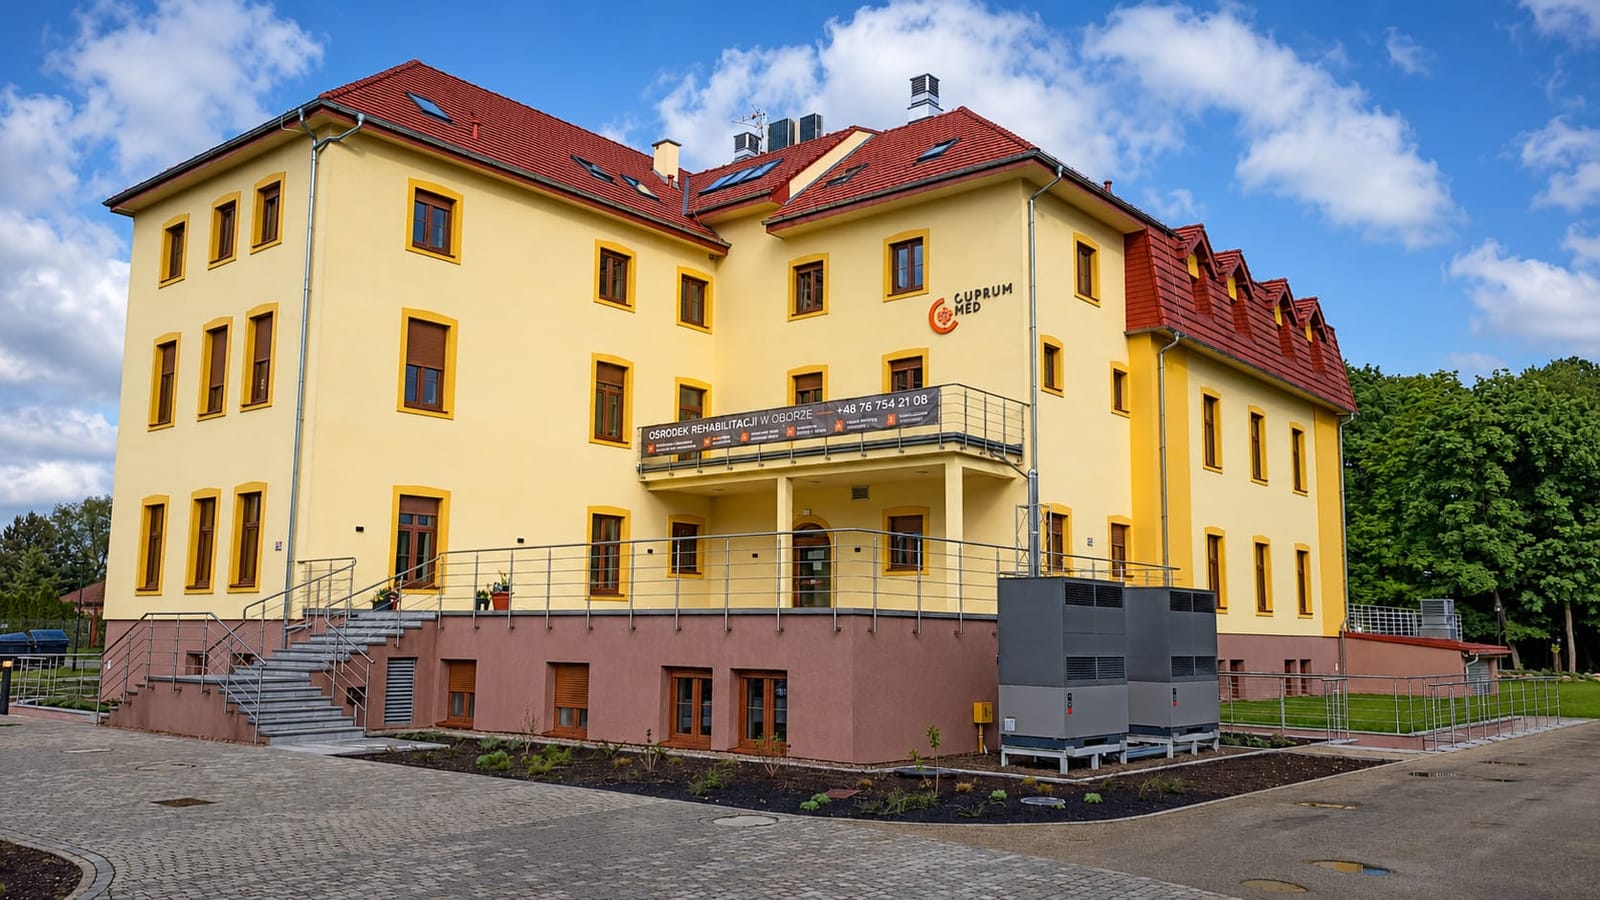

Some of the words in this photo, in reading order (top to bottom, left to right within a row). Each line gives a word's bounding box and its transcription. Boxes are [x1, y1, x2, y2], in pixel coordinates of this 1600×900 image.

[954, 283, 1013, 304] CUPRUM
[955, 302, 981, 316] MED
[837, 403, 857, 415] +48
[859, 402, 872, 412] 76
[875, 399, 895, 410] 754
[898, 397, 910, 408] 21
[913, 394, 928, 406] 08
[649, 426, 689, 440] OŚRODEK
[691, 417, 758, 435] REHABILITACJI
[759, 416, 770, 425] W
[771, 409, 813, 424] OBORZE
